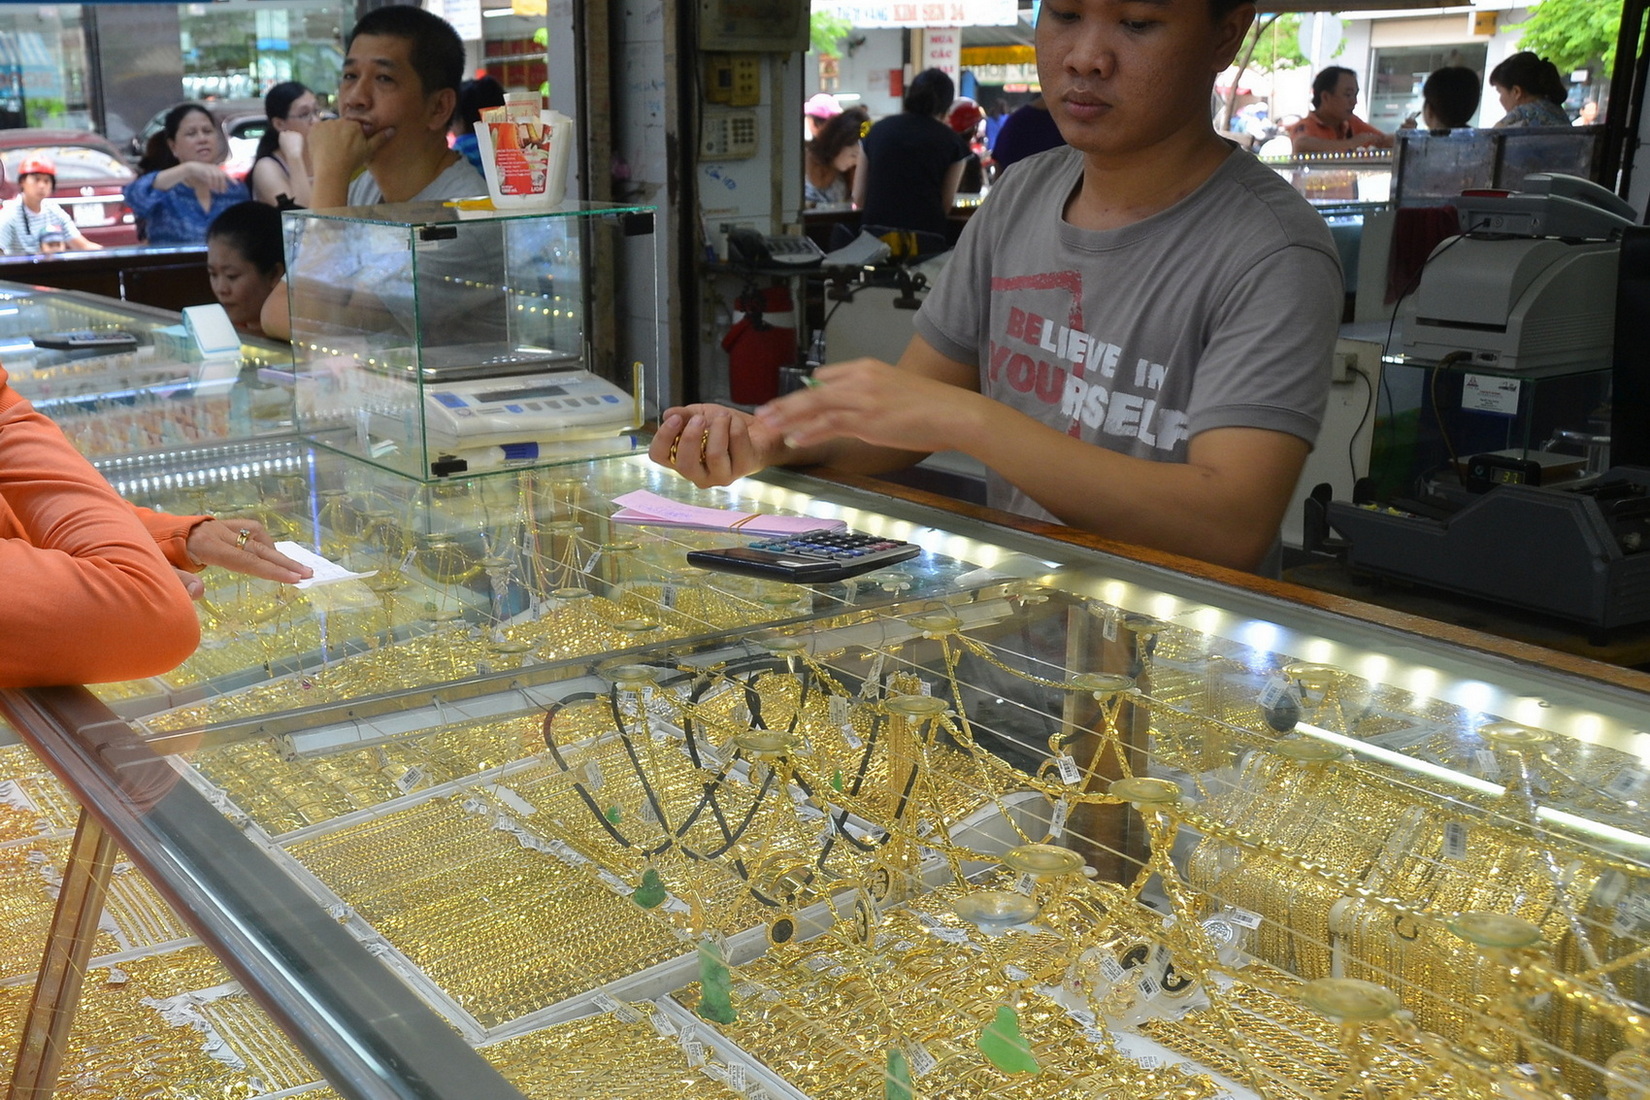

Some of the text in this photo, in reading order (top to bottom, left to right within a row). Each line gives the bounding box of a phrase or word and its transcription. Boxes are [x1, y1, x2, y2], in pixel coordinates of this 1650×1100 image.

[893, 4, 917, 21] KIM
[922, 4, 945, 21] SEN
[1005, 306, 1169, 391] BELIEVE IN
[989, 340, 1190, 450] YOURSELF
